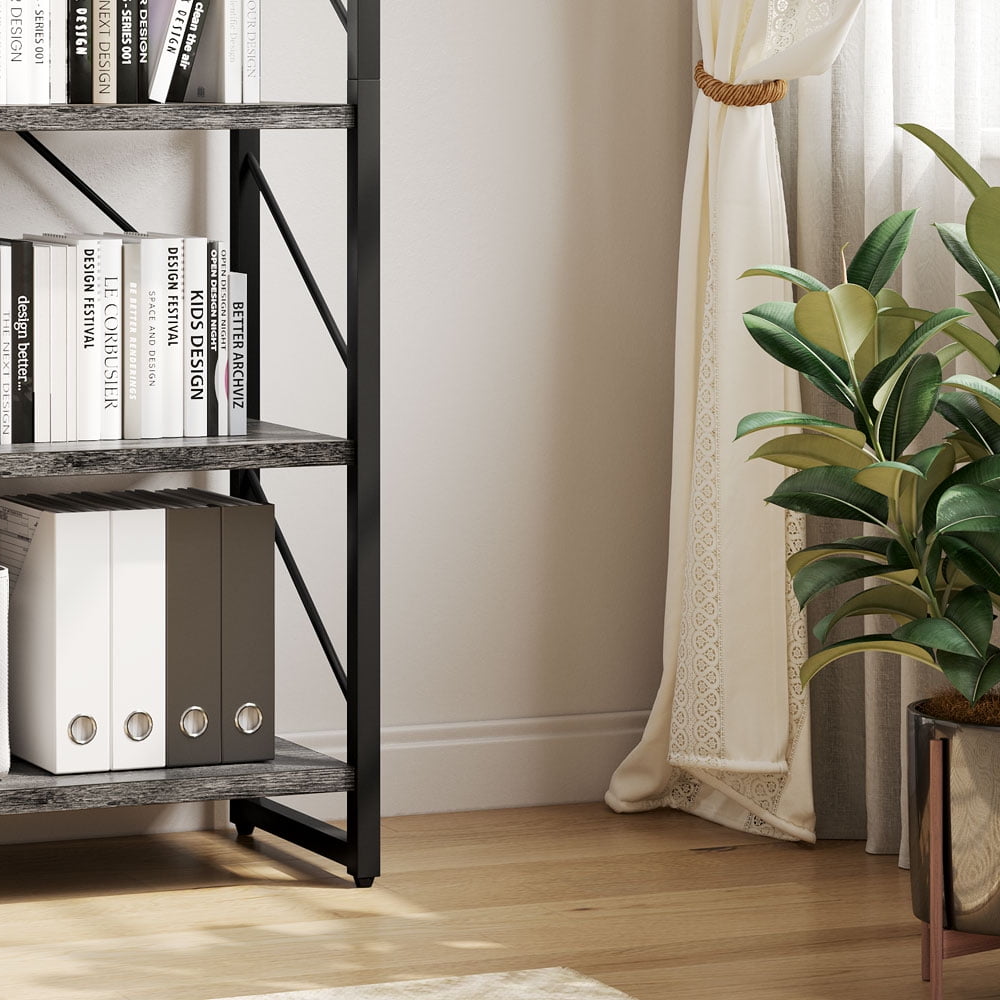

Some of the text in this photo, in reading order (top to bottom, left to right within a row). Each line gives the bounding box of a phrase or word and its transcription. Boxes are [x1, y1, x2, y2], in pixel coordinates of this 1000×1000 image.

[11, 8, 22, 62] DESIGN
[35, 10, 43, 44] SERIES
[76, 8, 87, 55] DESIGN
[99, 1, 110, 35] NEXT
[122, 10, 131, 44] SERIES
[167, 10, 189, 54] DESIGN
[190, 2, 204, 31] clean
[35, 47, 43, 64] 001
[122, 47, 131, 65] 001
[180, 53, 190, 70] air
[184, 32, 197, 50] the
[99, 43, 110, 94] DESIGN
[84, 249, 94, 349] DESIGN FESTIVAL
[130, 283, 137, 294] BE
[168, 248, 178, 346] DESIGN FESTIVAL
[14, 296, 29, 390] design better...
[105, 277, 118, 409] LE CORBUSIER
[191, 291, 203, 400] KIDS DESIGN
[233, 302, 243, 408] BETTER ARCHVIZ
